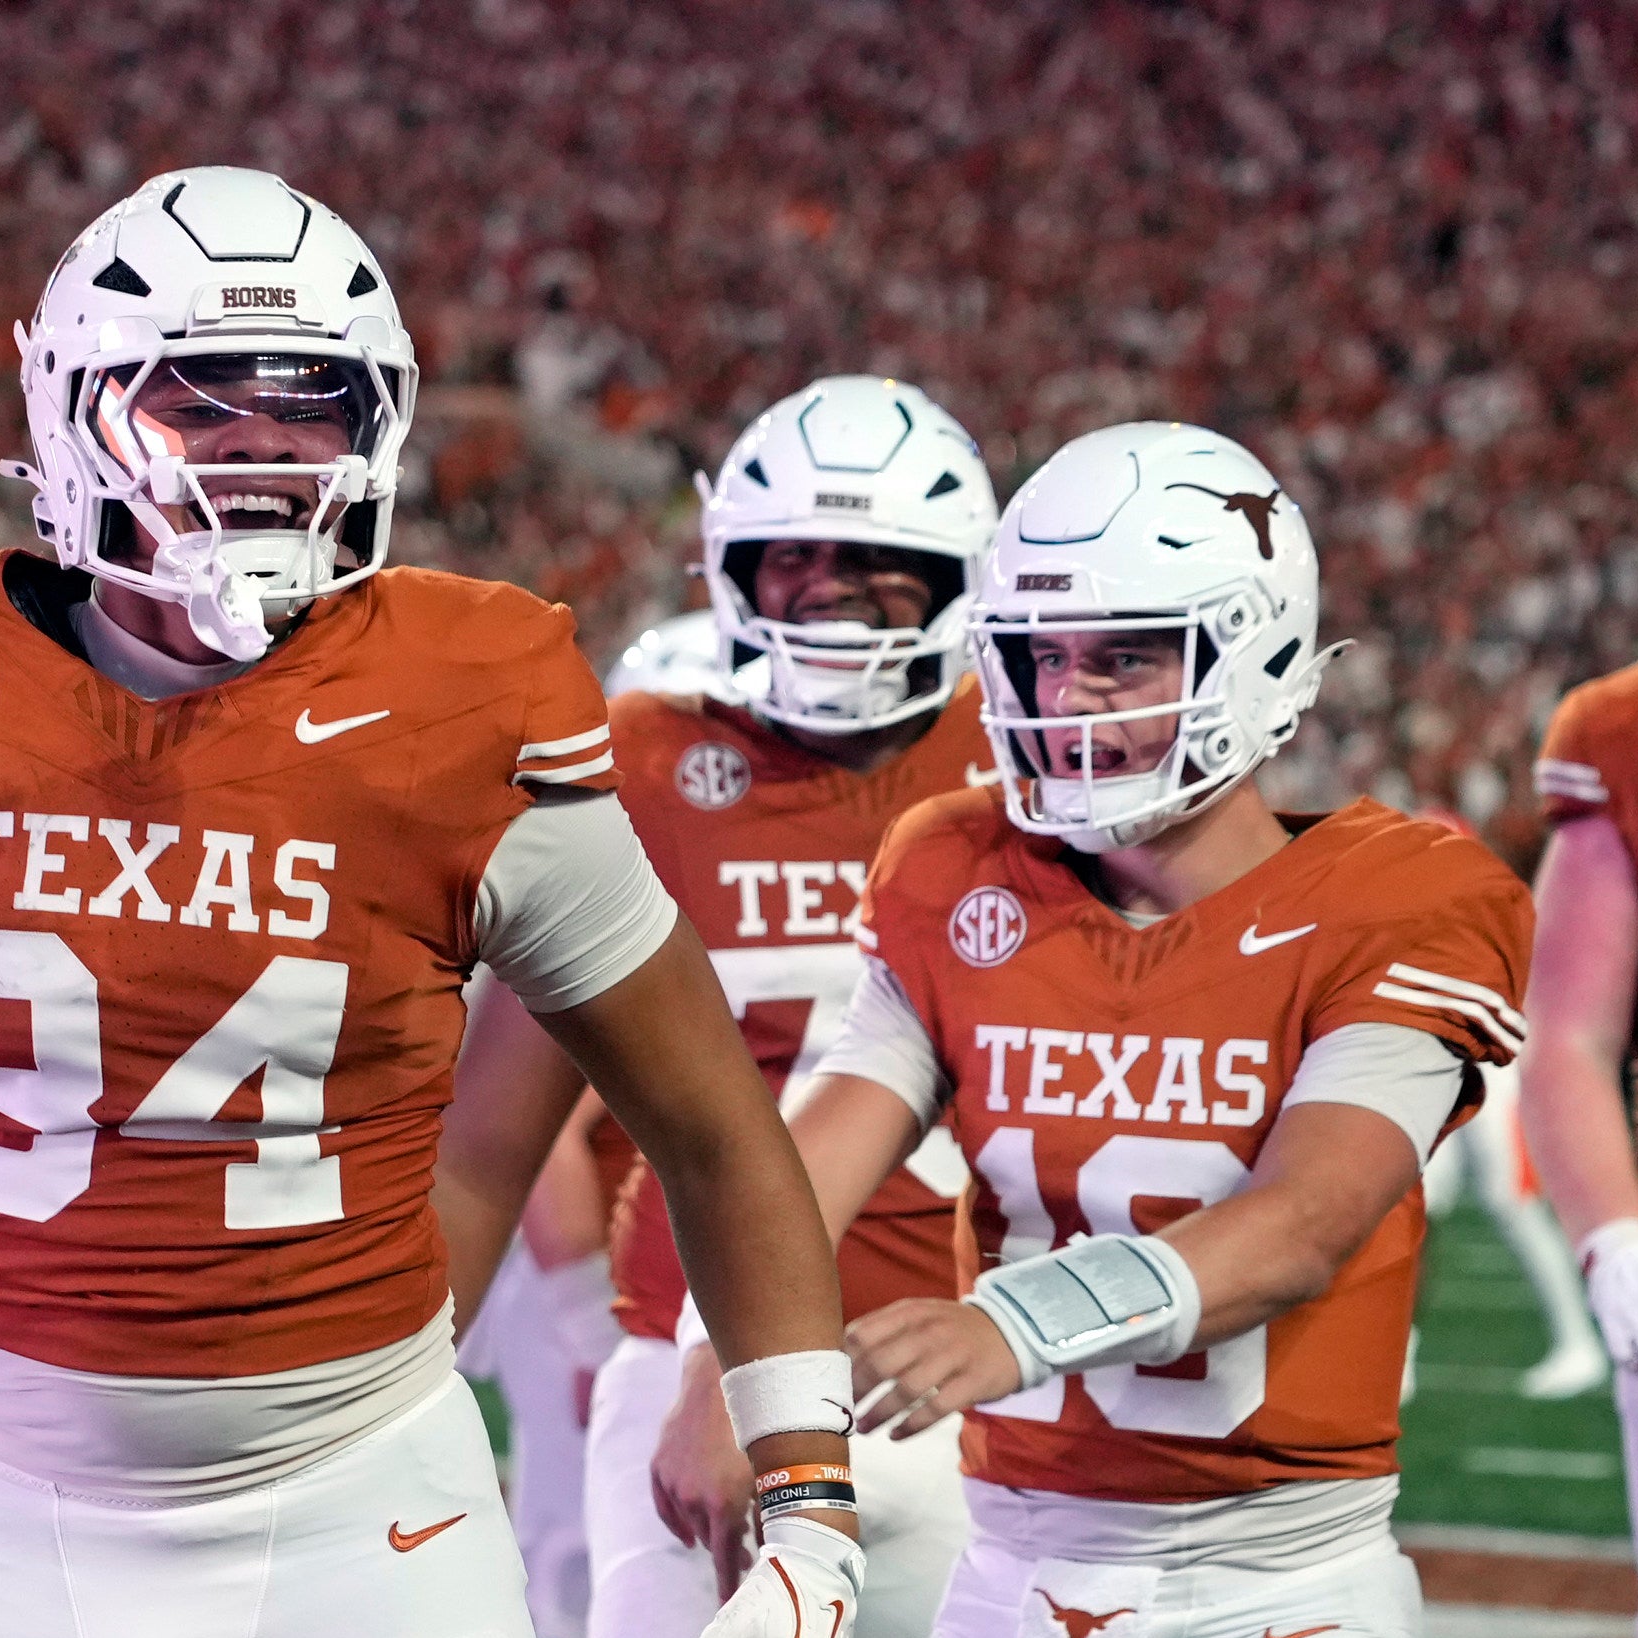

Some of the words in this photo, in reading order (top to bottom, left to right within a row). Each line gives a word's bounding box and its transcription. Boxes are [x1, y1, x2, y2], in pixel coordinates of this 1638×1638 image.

[221, 286, 297, 309] HORNS
[681, 745, 746, 806] SEC
[956, 892, 1019, 962] SEC
[974, 1023, 1270, 1128] TEXAS
[763, 1470, 790, 1487] GOD
[780, 1485, 810, 1500] FIND
